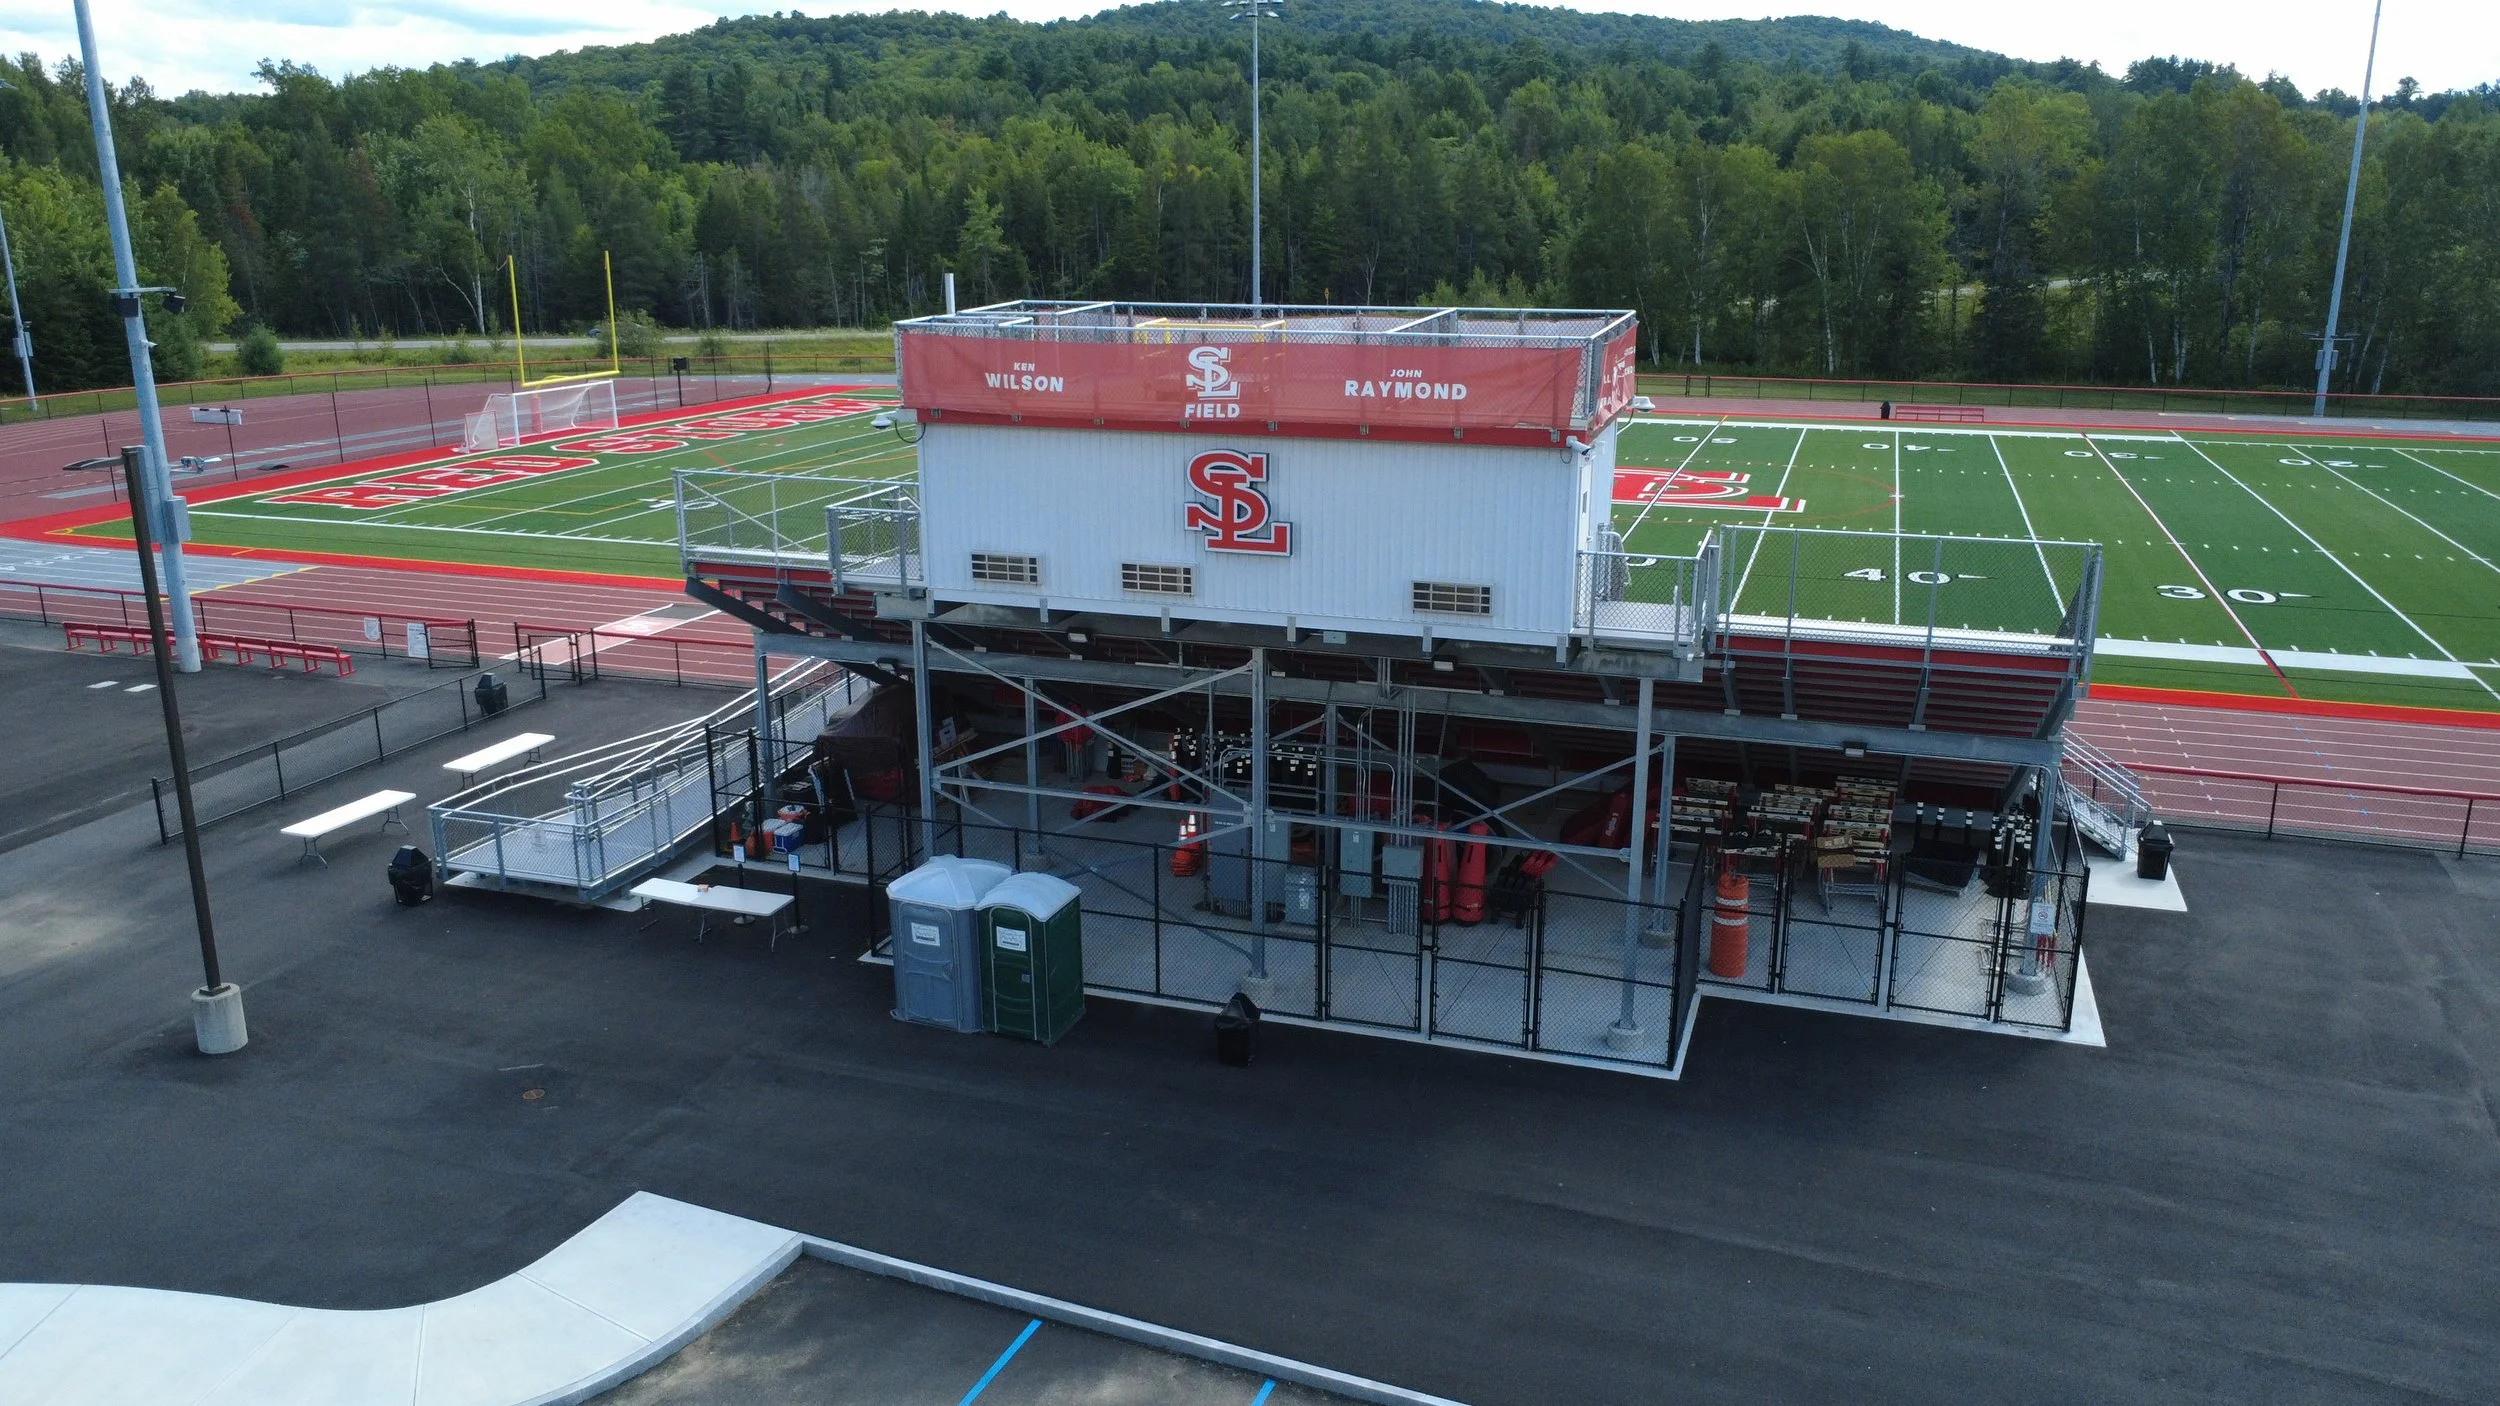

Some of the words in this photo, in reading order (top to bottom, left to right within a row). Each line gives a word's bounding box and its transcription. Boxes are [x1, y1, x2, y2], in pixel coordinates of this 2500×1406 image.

[1013, 362, 1035, 372] KEN
[1390, 369, 1422, 378] JOHN
[985, 372, 1064, 392] WILSON
[1344, 380, 1467, 400] RAYMOND
[1184, 403, 1240, 418] FIELD
[252, 455, 600, 510] RED
[2155, 585, 2277, 603] 30
